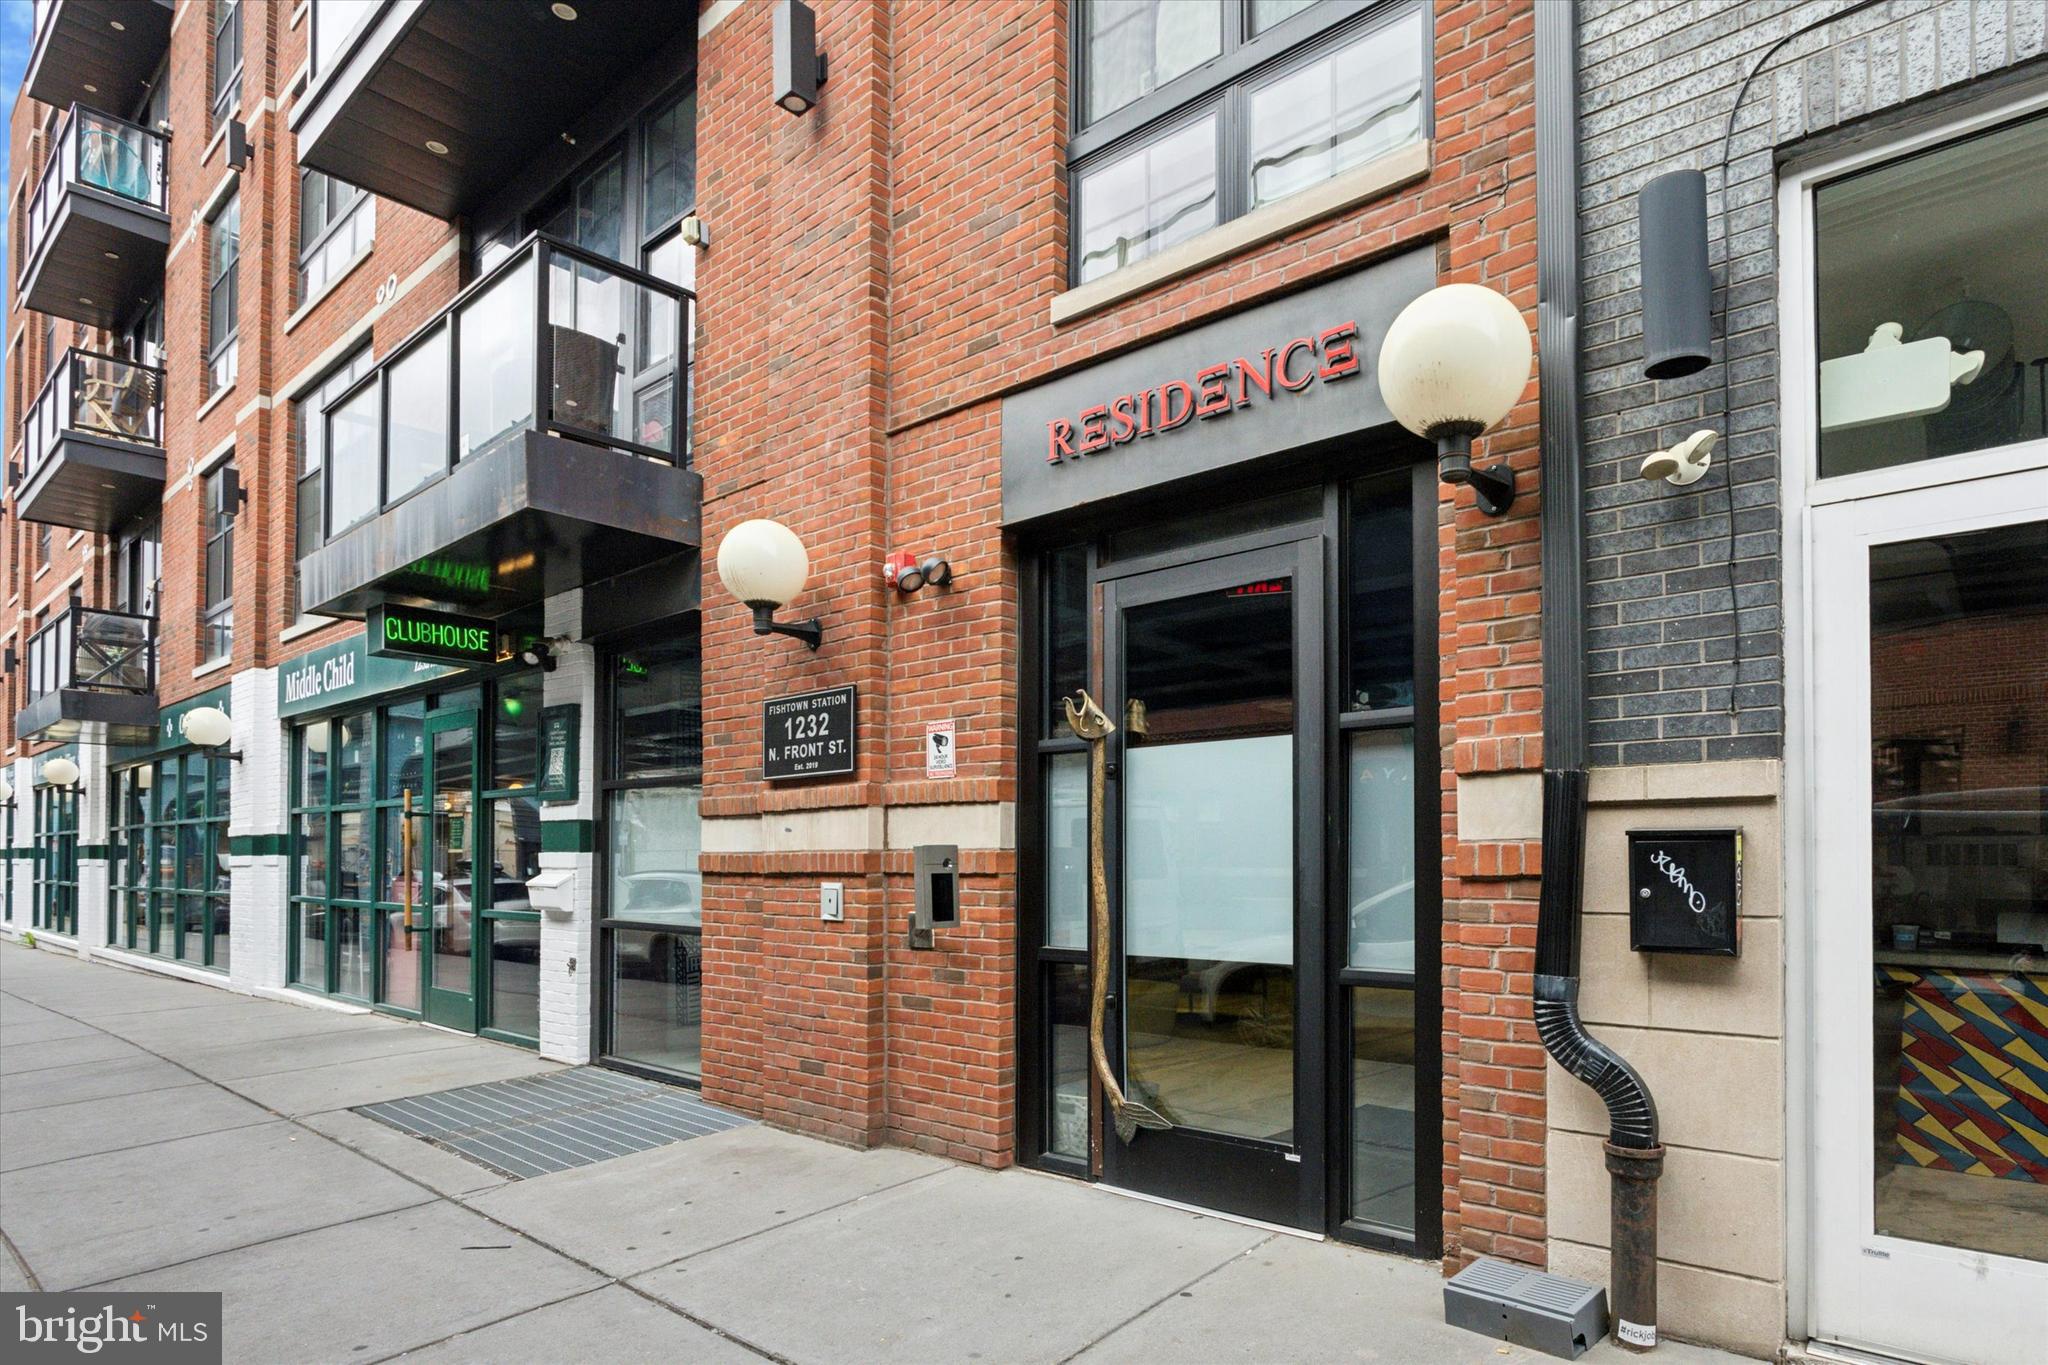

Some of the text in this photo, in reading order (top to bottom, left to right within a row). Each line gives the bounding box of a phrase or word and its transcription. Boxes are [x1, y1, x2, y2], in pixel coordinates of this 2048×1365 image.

[1045, 320, 1361, 465] RESIDENCE
[386, 617, 490, 651] CLUBHOUSE
[285, 650, 355, 704] Middle Child
[768, 693, 847, 716] FISHTOWN STATION
[784, 712, 829, 740] 1232
[768, 739, 847, 762] N. FRONT ST.
[794, 763, 805, 771] Est.
